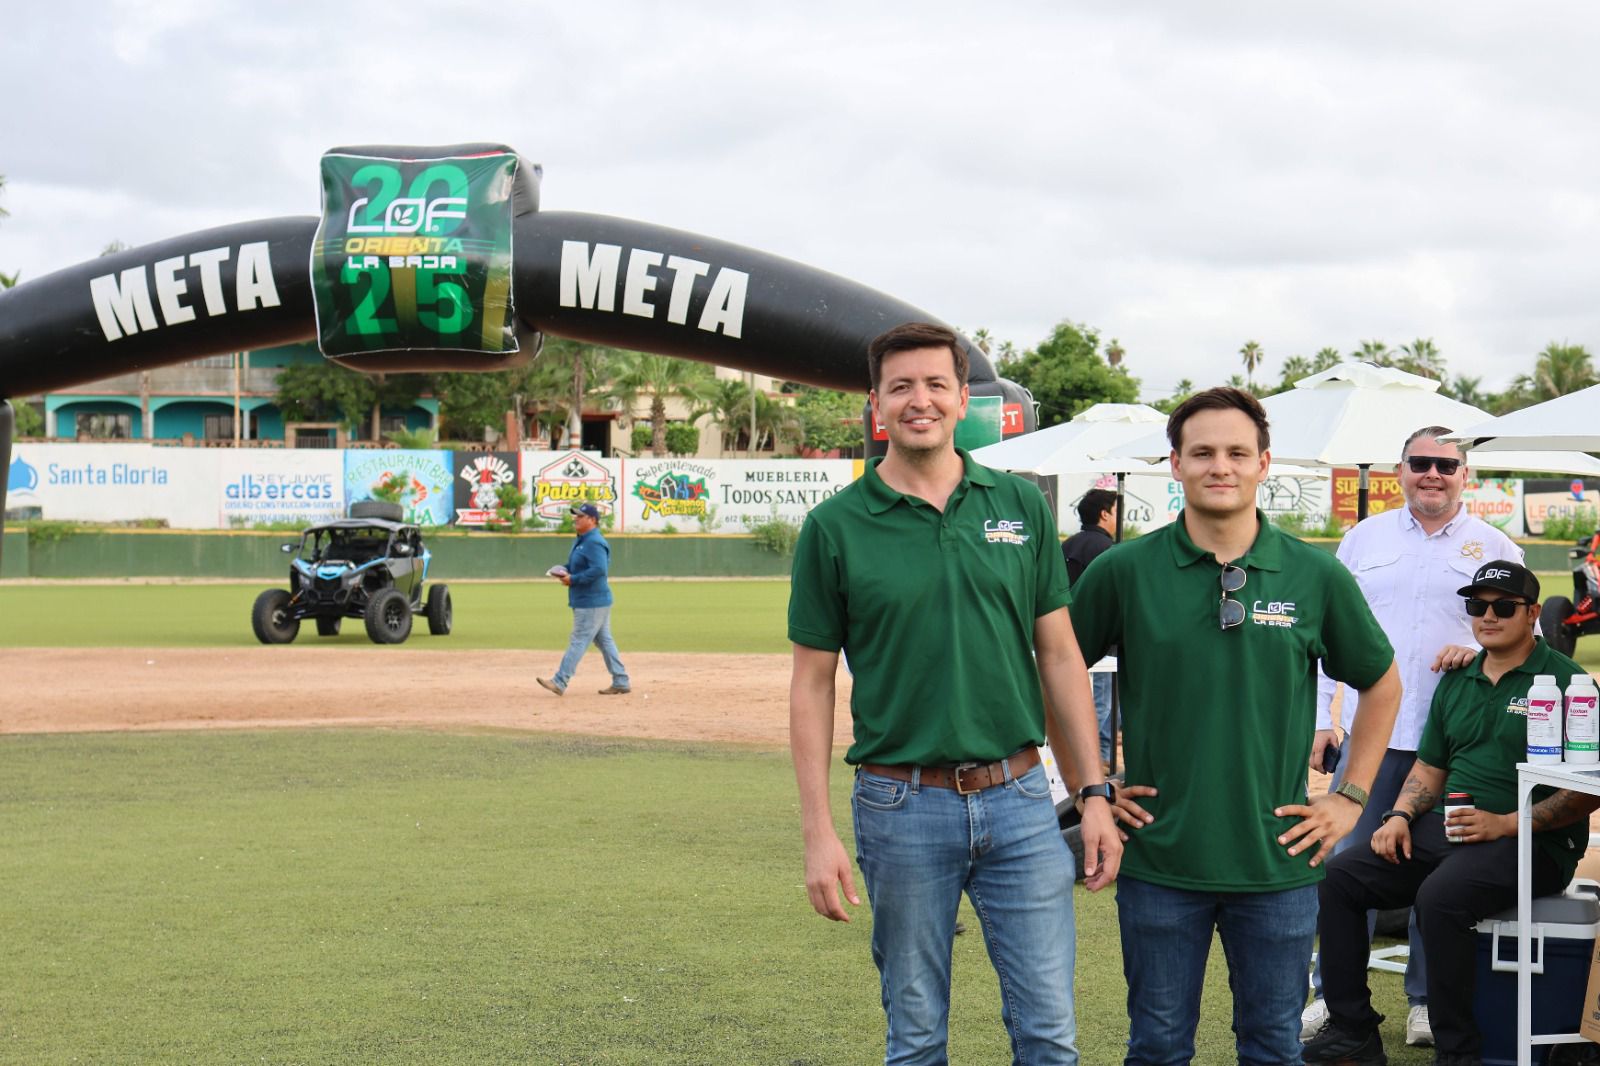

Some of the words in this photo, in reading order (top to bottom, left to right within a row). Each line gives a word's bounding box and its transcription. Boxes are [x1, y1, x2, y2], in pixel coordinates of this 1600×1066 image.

[347, 197, 467, 232] LOF
[345, 237, 464, 253] ORIENTA
[347, 256, 379, 269] LA
[388, 256, 457, 269] BAJA
[90, 241, 281, 342] META
[559, 240, 749, 339] META
[48, 463, 106, 485] Santa
[112, 463, 168, 485] Gloria
[460, 464, 479, 482] EL
[635, 459, 717, 482] Supermercado
[745, 471, 829, 483] MUEBLERIA
[225, 474, 332, 499] albercas
[720, 484, 772, 505] TODOS
[1335, 480, 1379, 495] SUPR
[1475, 568, 1511, 582] LOF
[1253, 600, 1296, 614] LOF
[1509, 696, 1528, 707] LO
